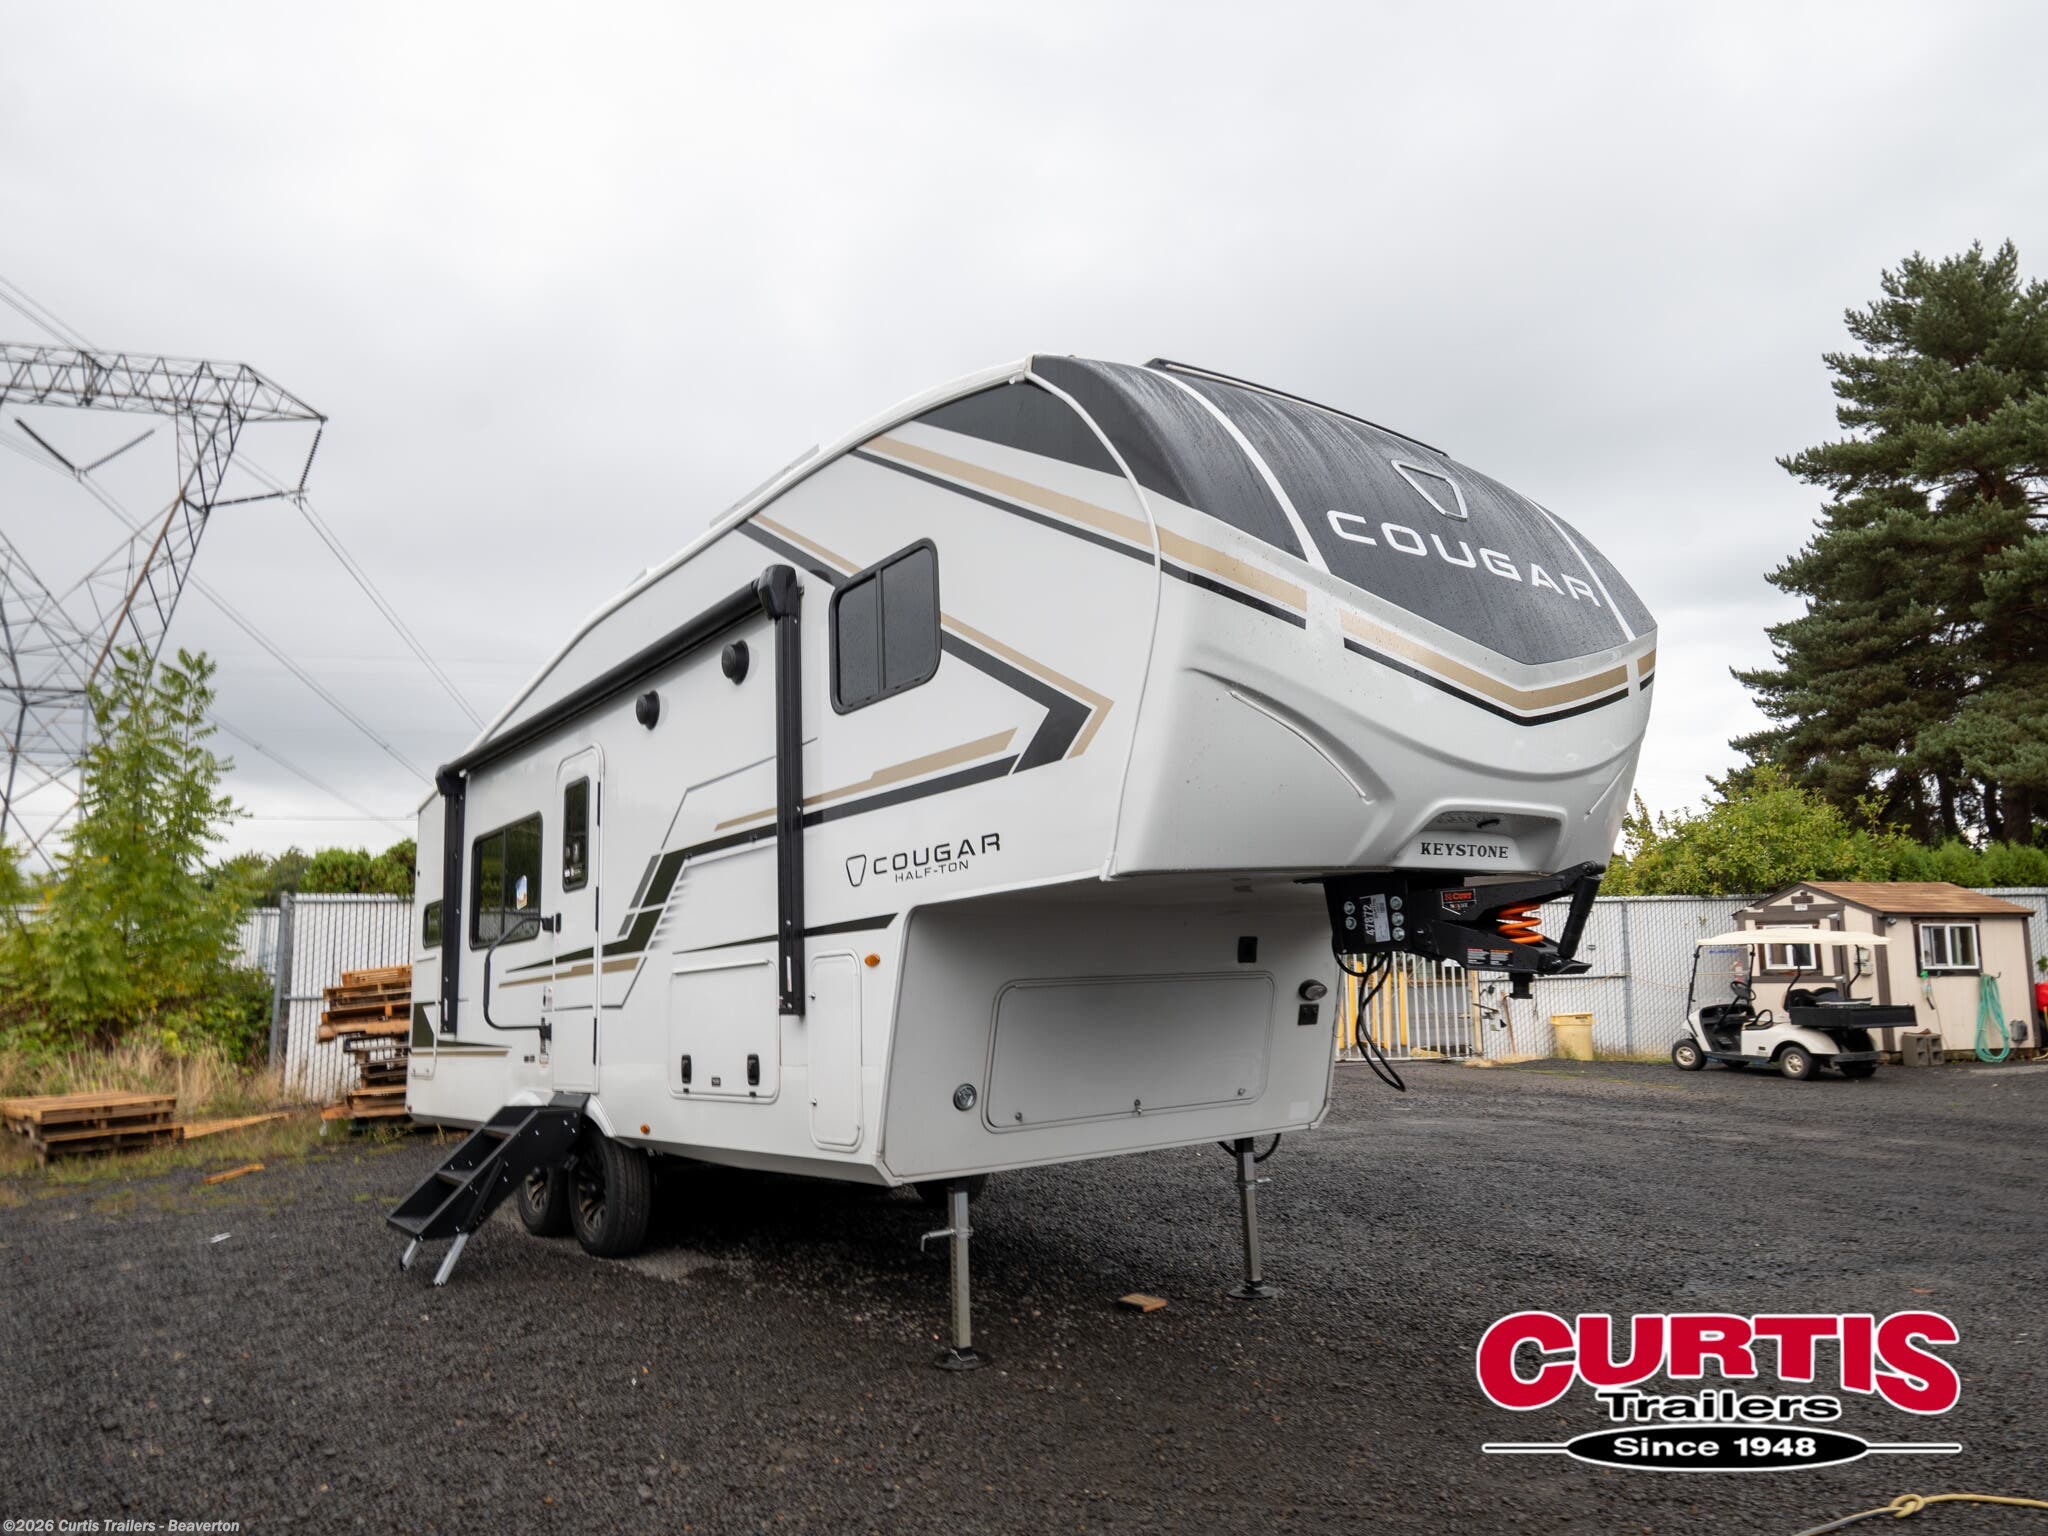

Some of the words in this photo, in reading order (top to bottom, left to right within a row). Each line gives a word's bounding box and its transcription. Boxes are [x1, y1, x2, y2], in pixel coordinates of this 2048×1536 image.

[1327, 510, 1601, 607] COUGAR
[873, 833, 1000, 875] COUGAR
[1420, 842, 1509, 859] KEYSTONE
[895, 860, 969, 883] HALF-TON
[1362, 904, 1376, 936] 47872
